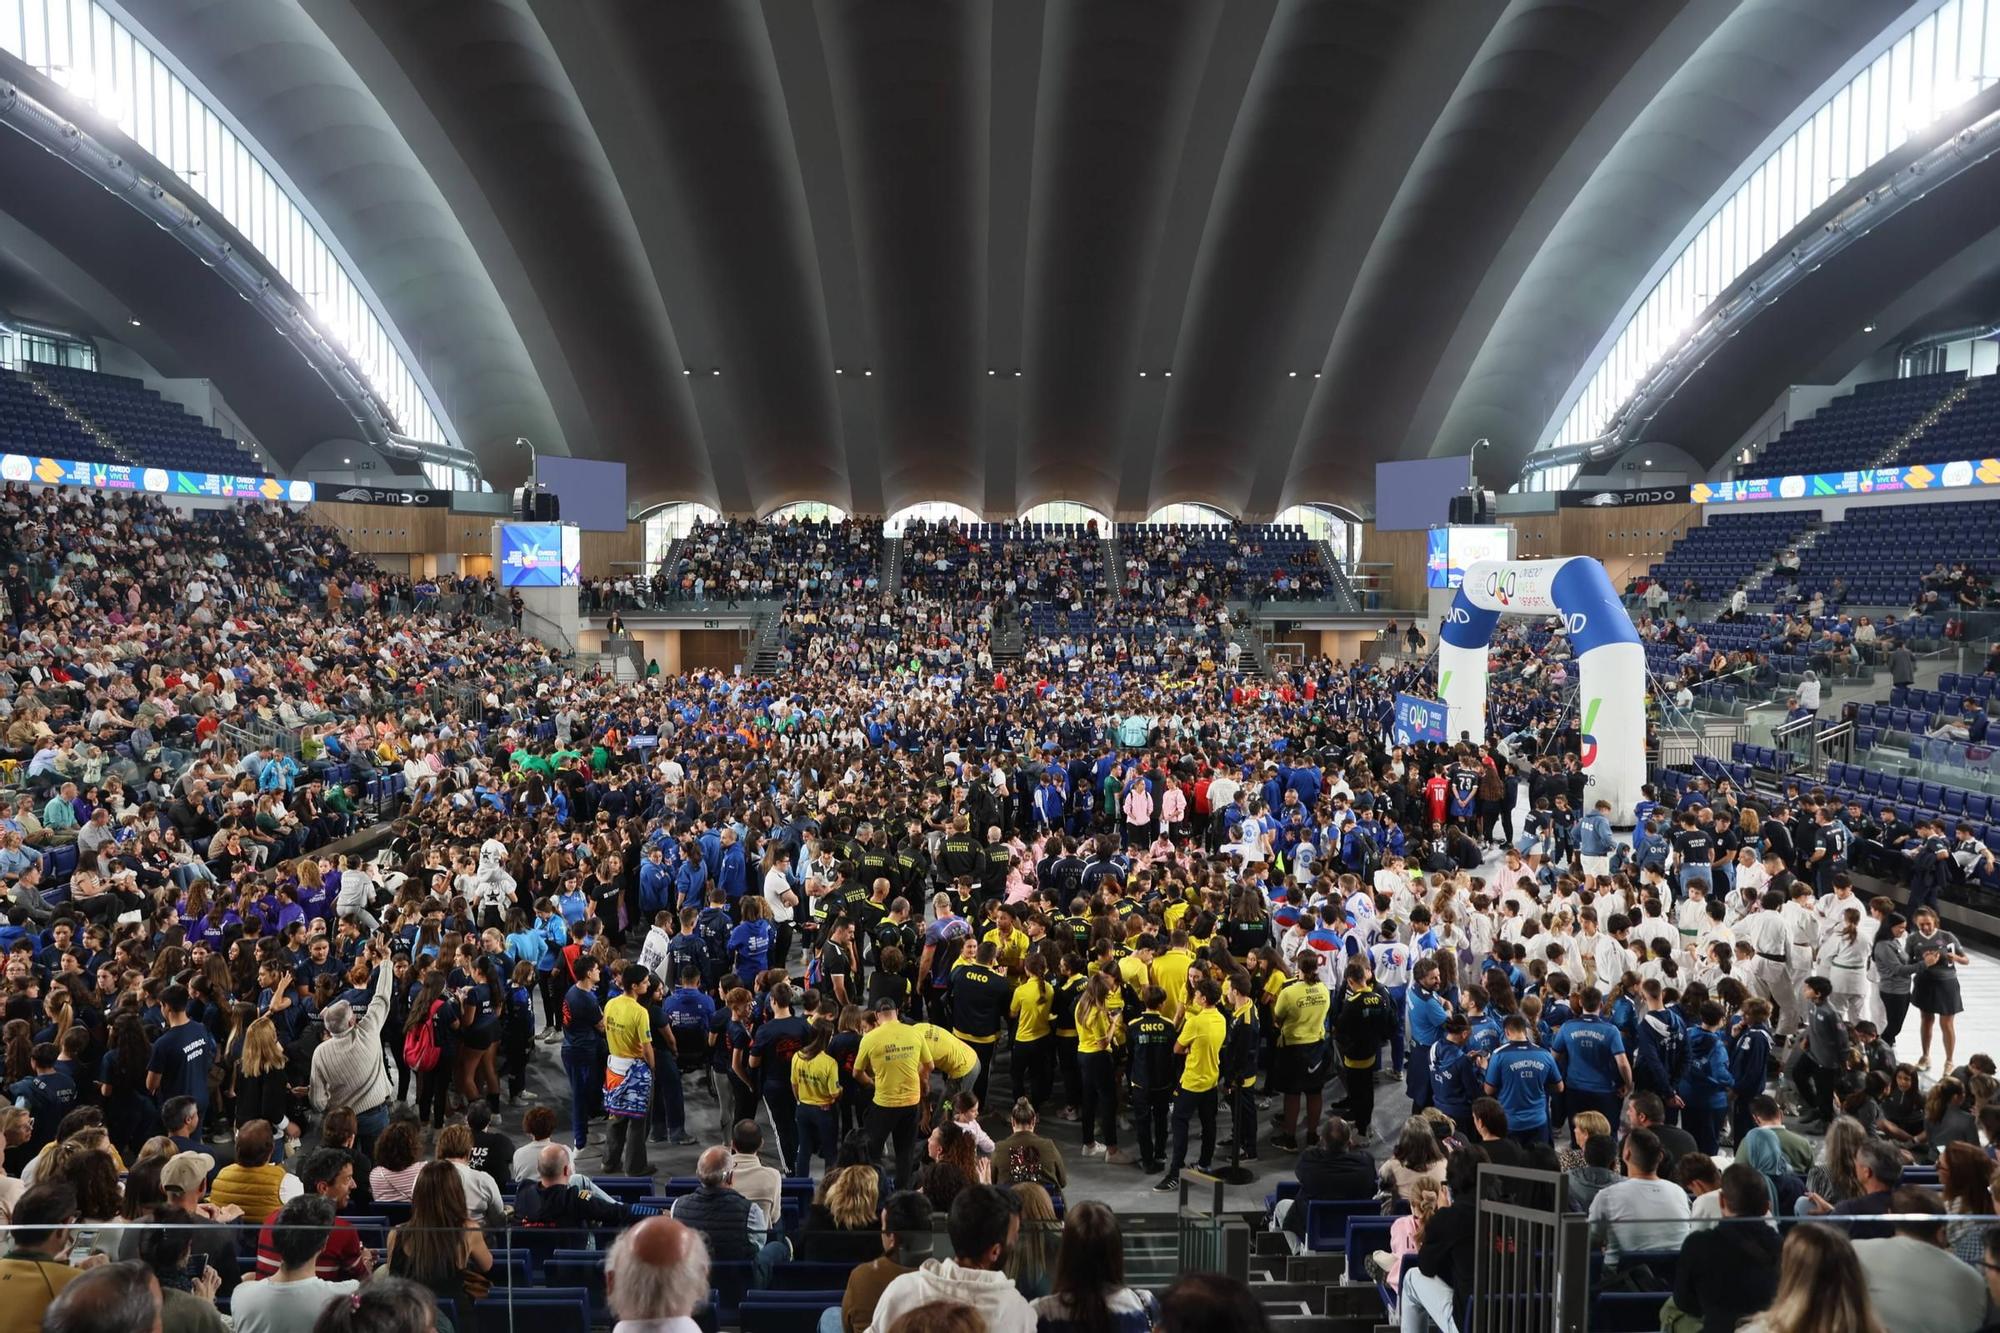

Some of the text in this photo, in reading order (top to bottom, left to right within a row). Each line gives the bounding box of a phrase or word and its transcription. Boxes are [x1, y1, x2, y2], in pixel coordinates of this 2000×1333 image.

[109, 466, 131, 474] OVIEDO
[1410, 704, 1428, 729] OVD
[1434, 788, 1444, 800] 10
[1432, 841, 1445, 853] 12
[966, 971, 988, 983] CNCO
[1140, 1023, 1164, 1032] CNCO
[1570, 1030, 1605, 1041] PRINCIPADO
[182, 1038, 206, 1054] VOLEIBOL
[187, 1048, 203, 1062] OVIEDO
[1510, 1060, 1544, 1071] PRINCIPADO
